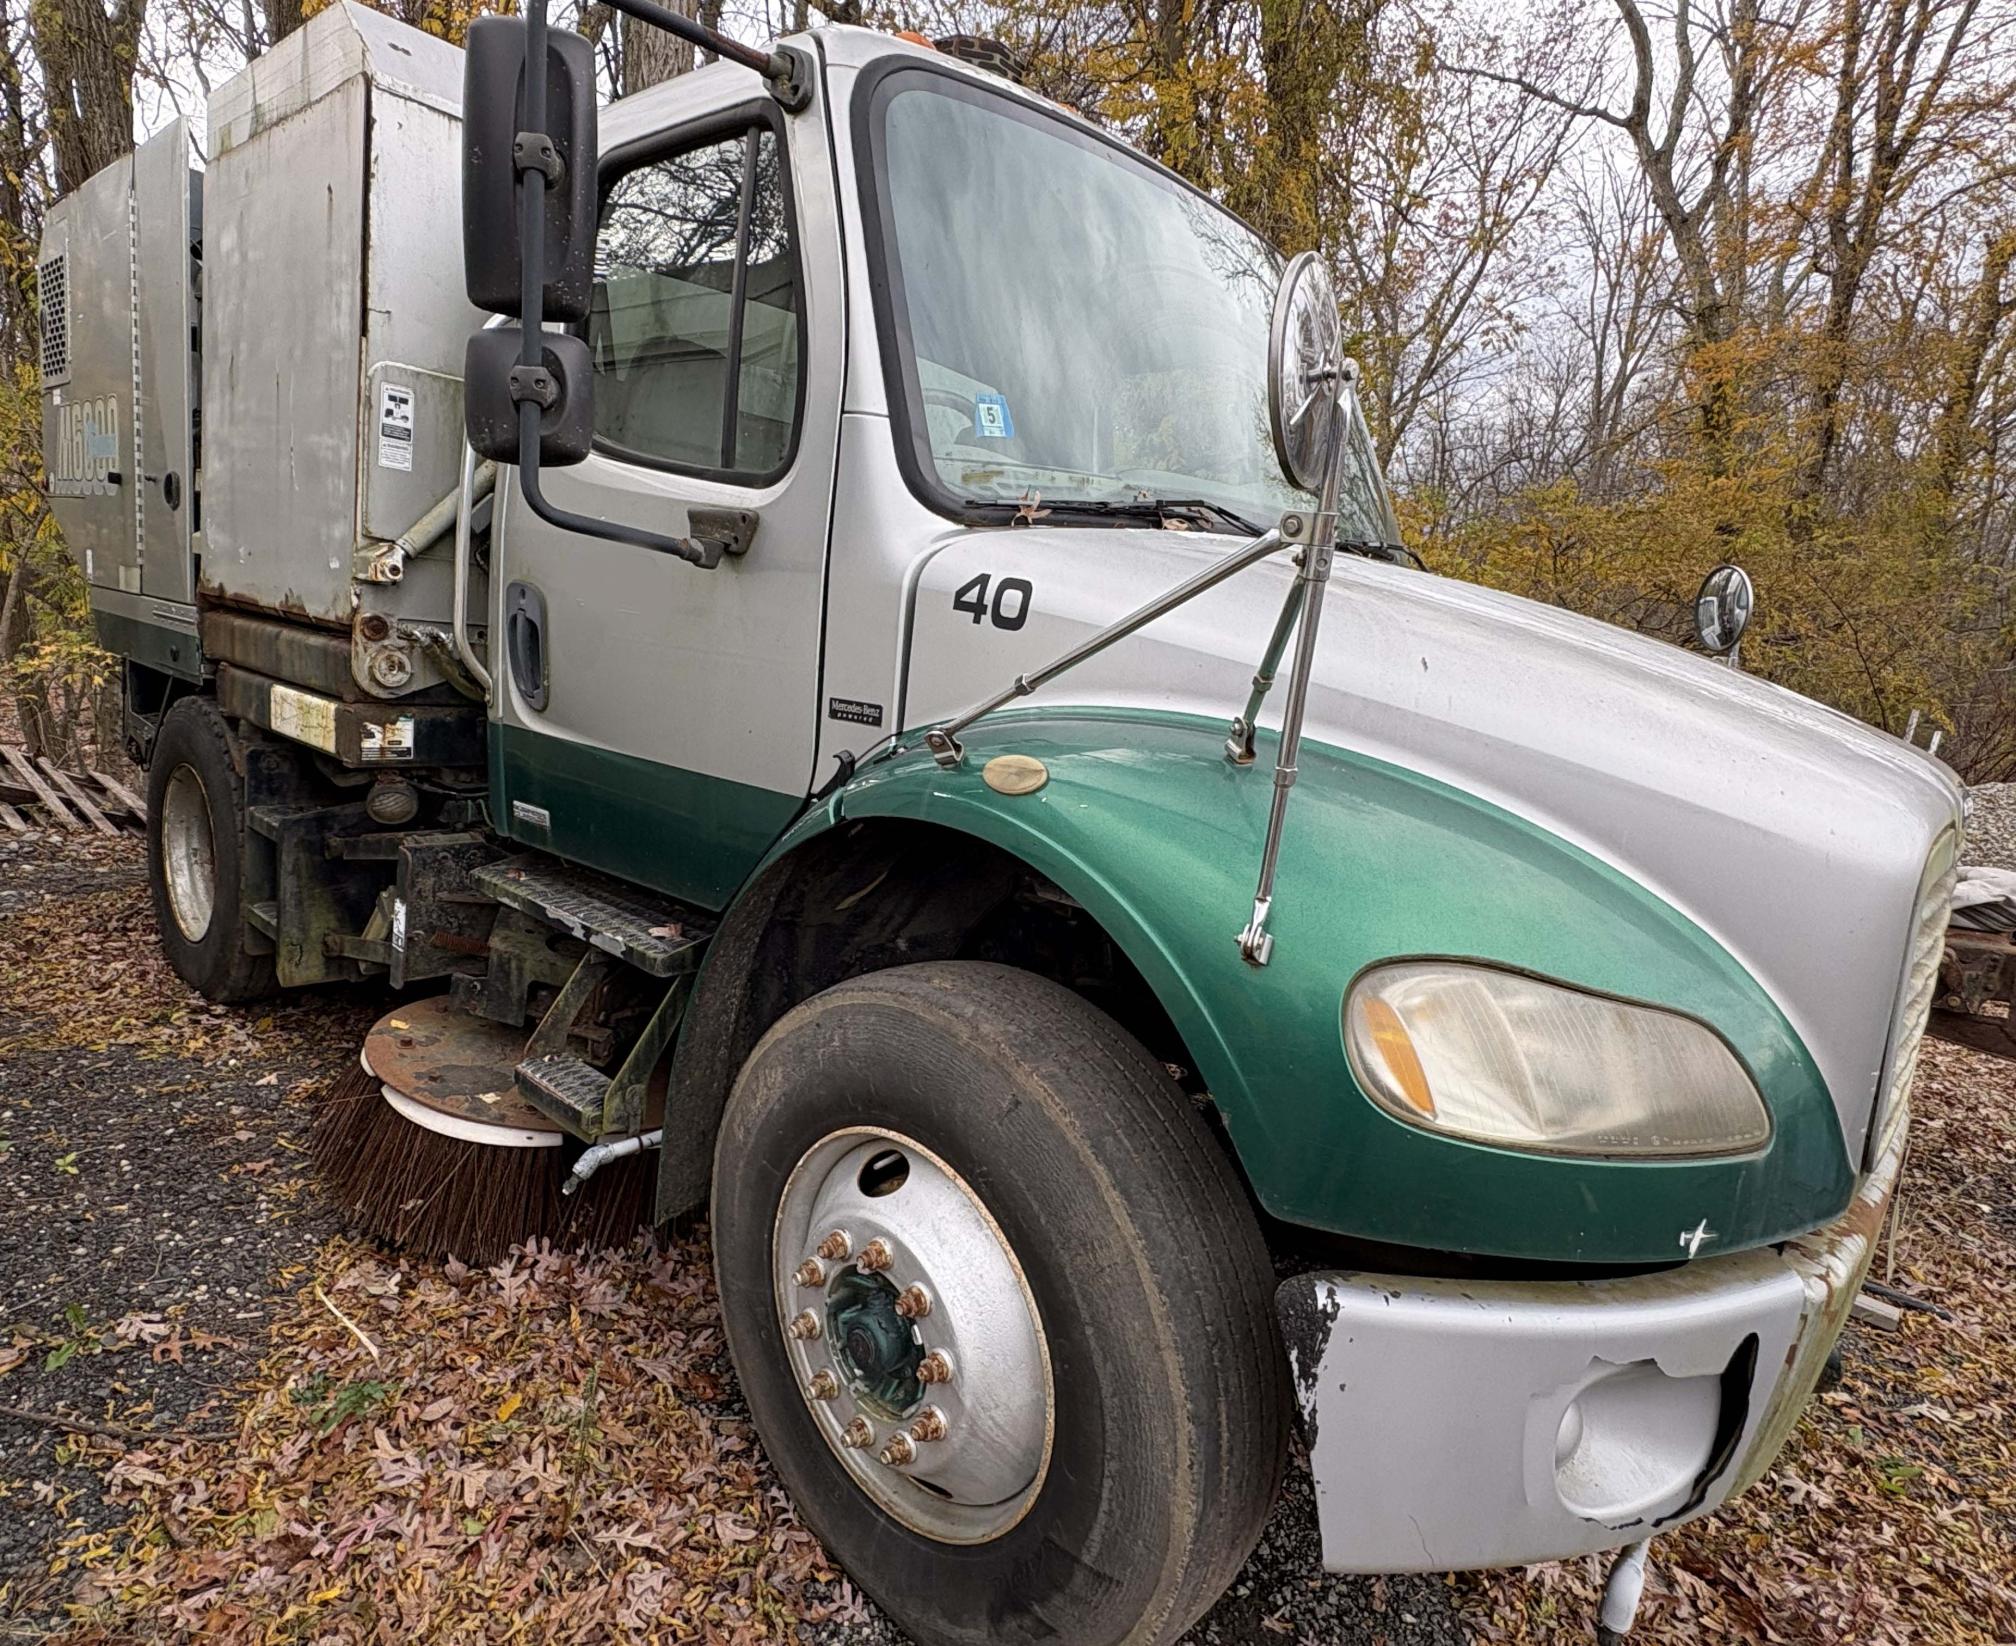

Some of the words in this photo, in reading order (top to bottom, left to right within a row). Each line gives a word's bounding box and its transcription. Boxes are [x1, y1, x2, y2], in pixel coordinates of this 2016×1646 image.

[986, 406, 996, 424] 5
[952, 572, 1033, 631] 40
[832, 700, 880, 718] Mercedes-Benz
